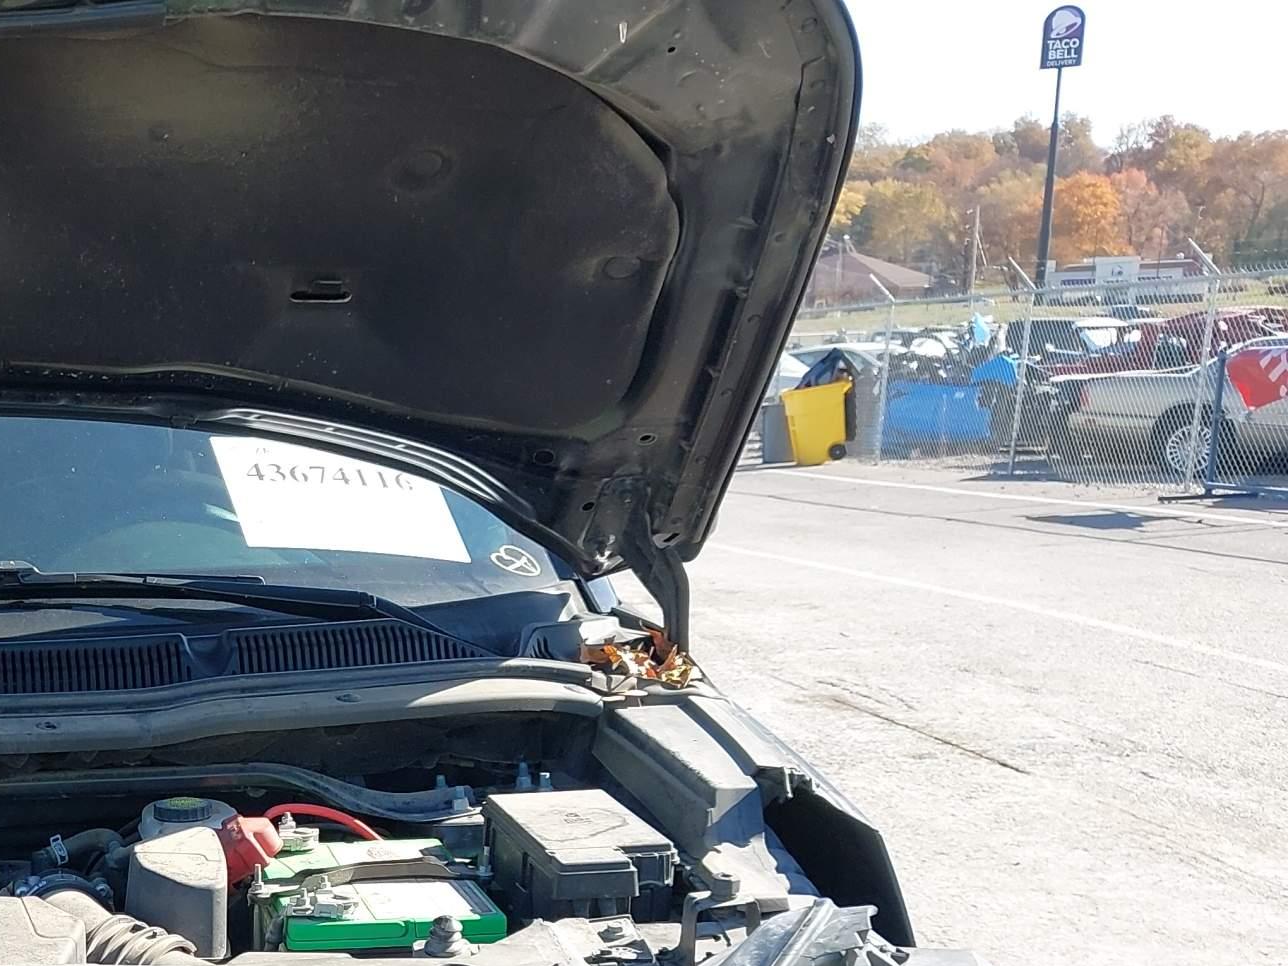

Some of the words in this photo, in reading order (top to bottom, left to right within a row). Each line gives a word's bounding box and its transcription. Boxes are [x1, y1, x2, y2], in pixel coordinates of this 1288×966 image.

[1047, 38, 1080, 50] TACO
[1048, 49, 1078, 60] BELL
[1046, 59, 1077, 67] DELIVERY
[246, 463, 414, 491] 43674116
